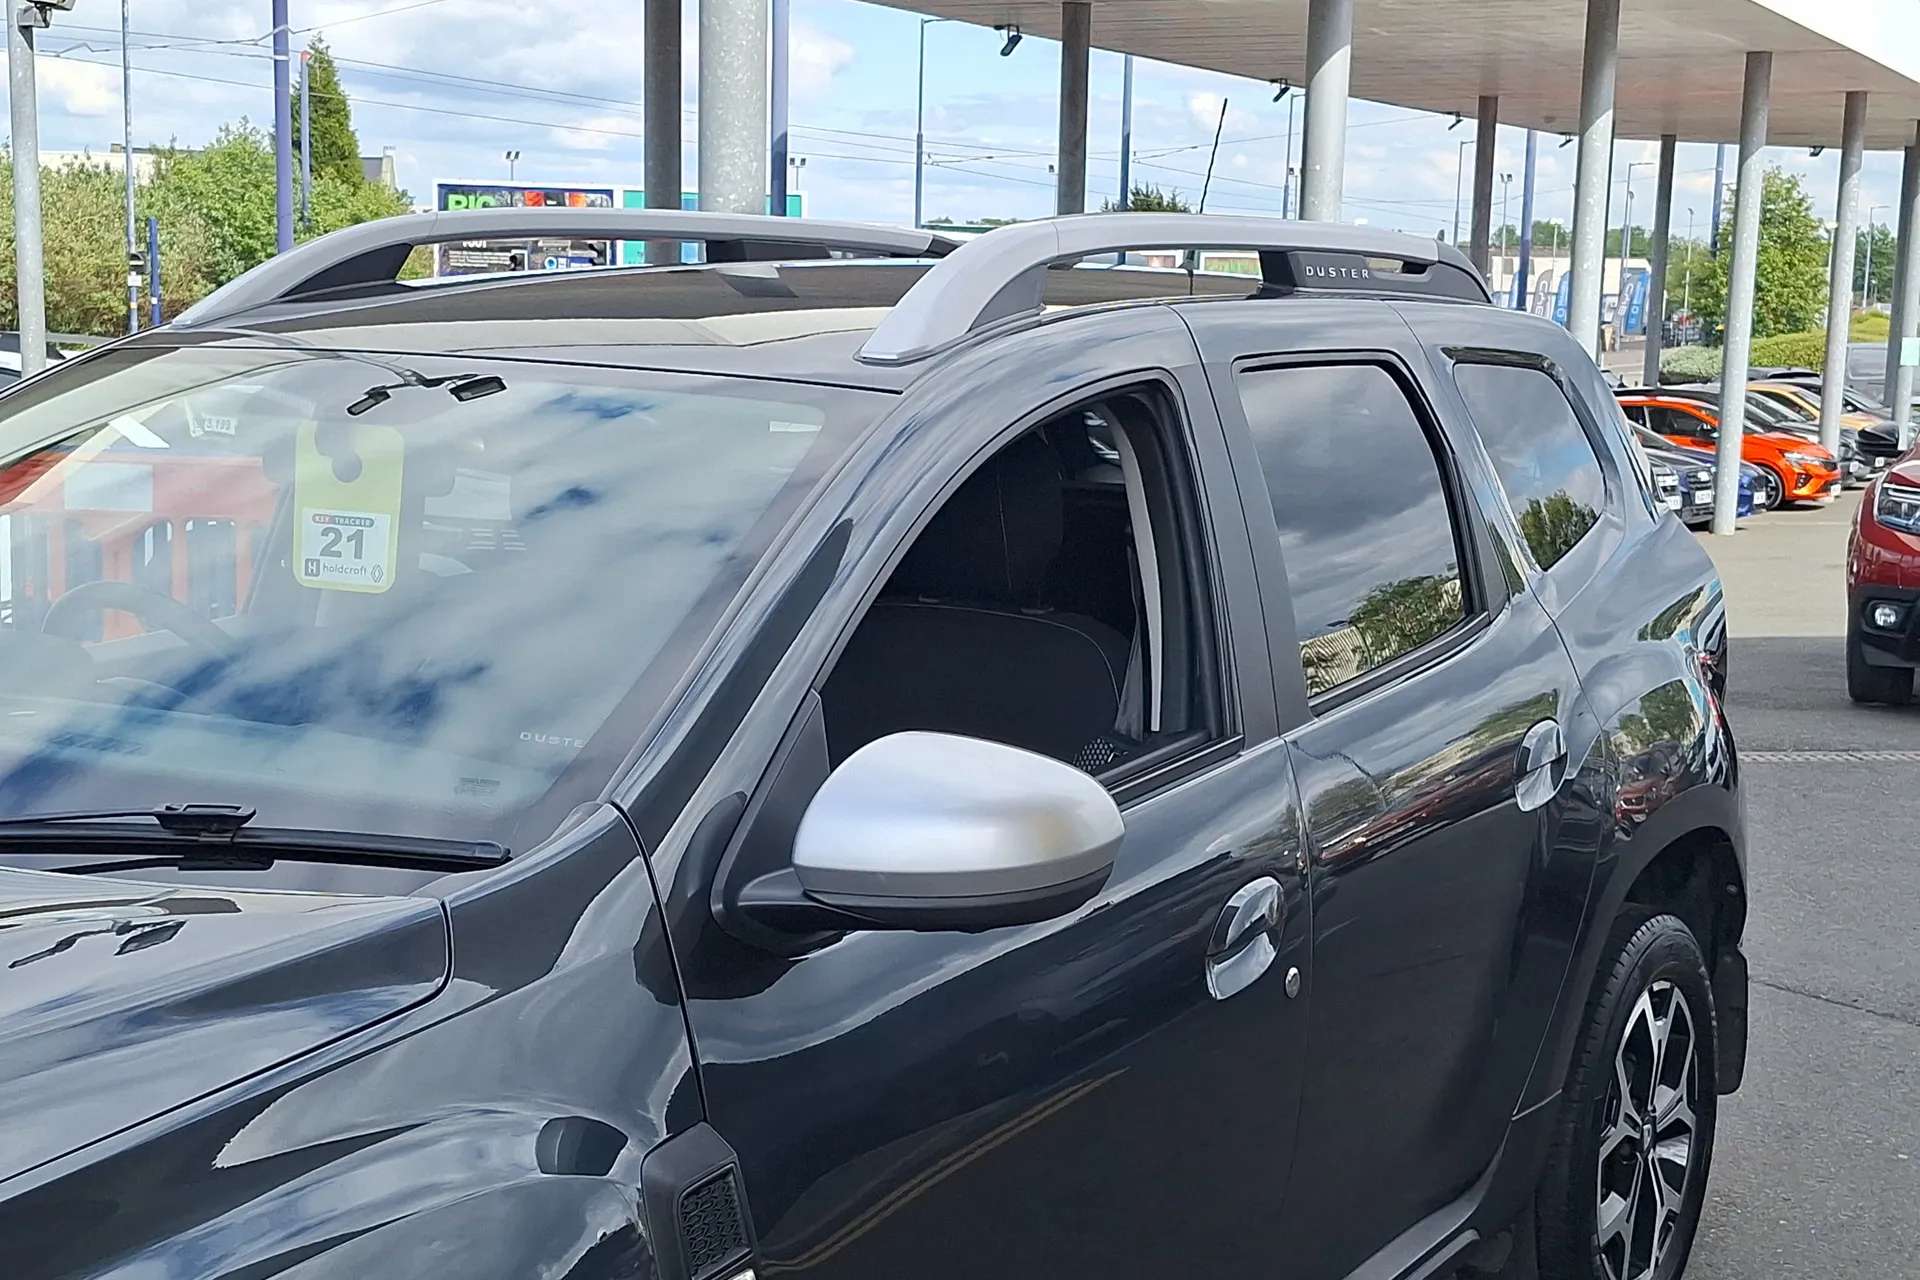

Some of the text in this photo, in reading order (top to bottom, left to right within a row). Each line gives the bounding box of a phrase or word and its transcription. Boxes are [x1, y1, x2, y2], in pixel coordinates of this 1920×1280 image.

[1306, 266, 1369, 279] DUSTER
[336, 517, 371, 527] TRACKER
[320, 527, 364, 559] 21
[322, 562, 367, 576] holdcroft
